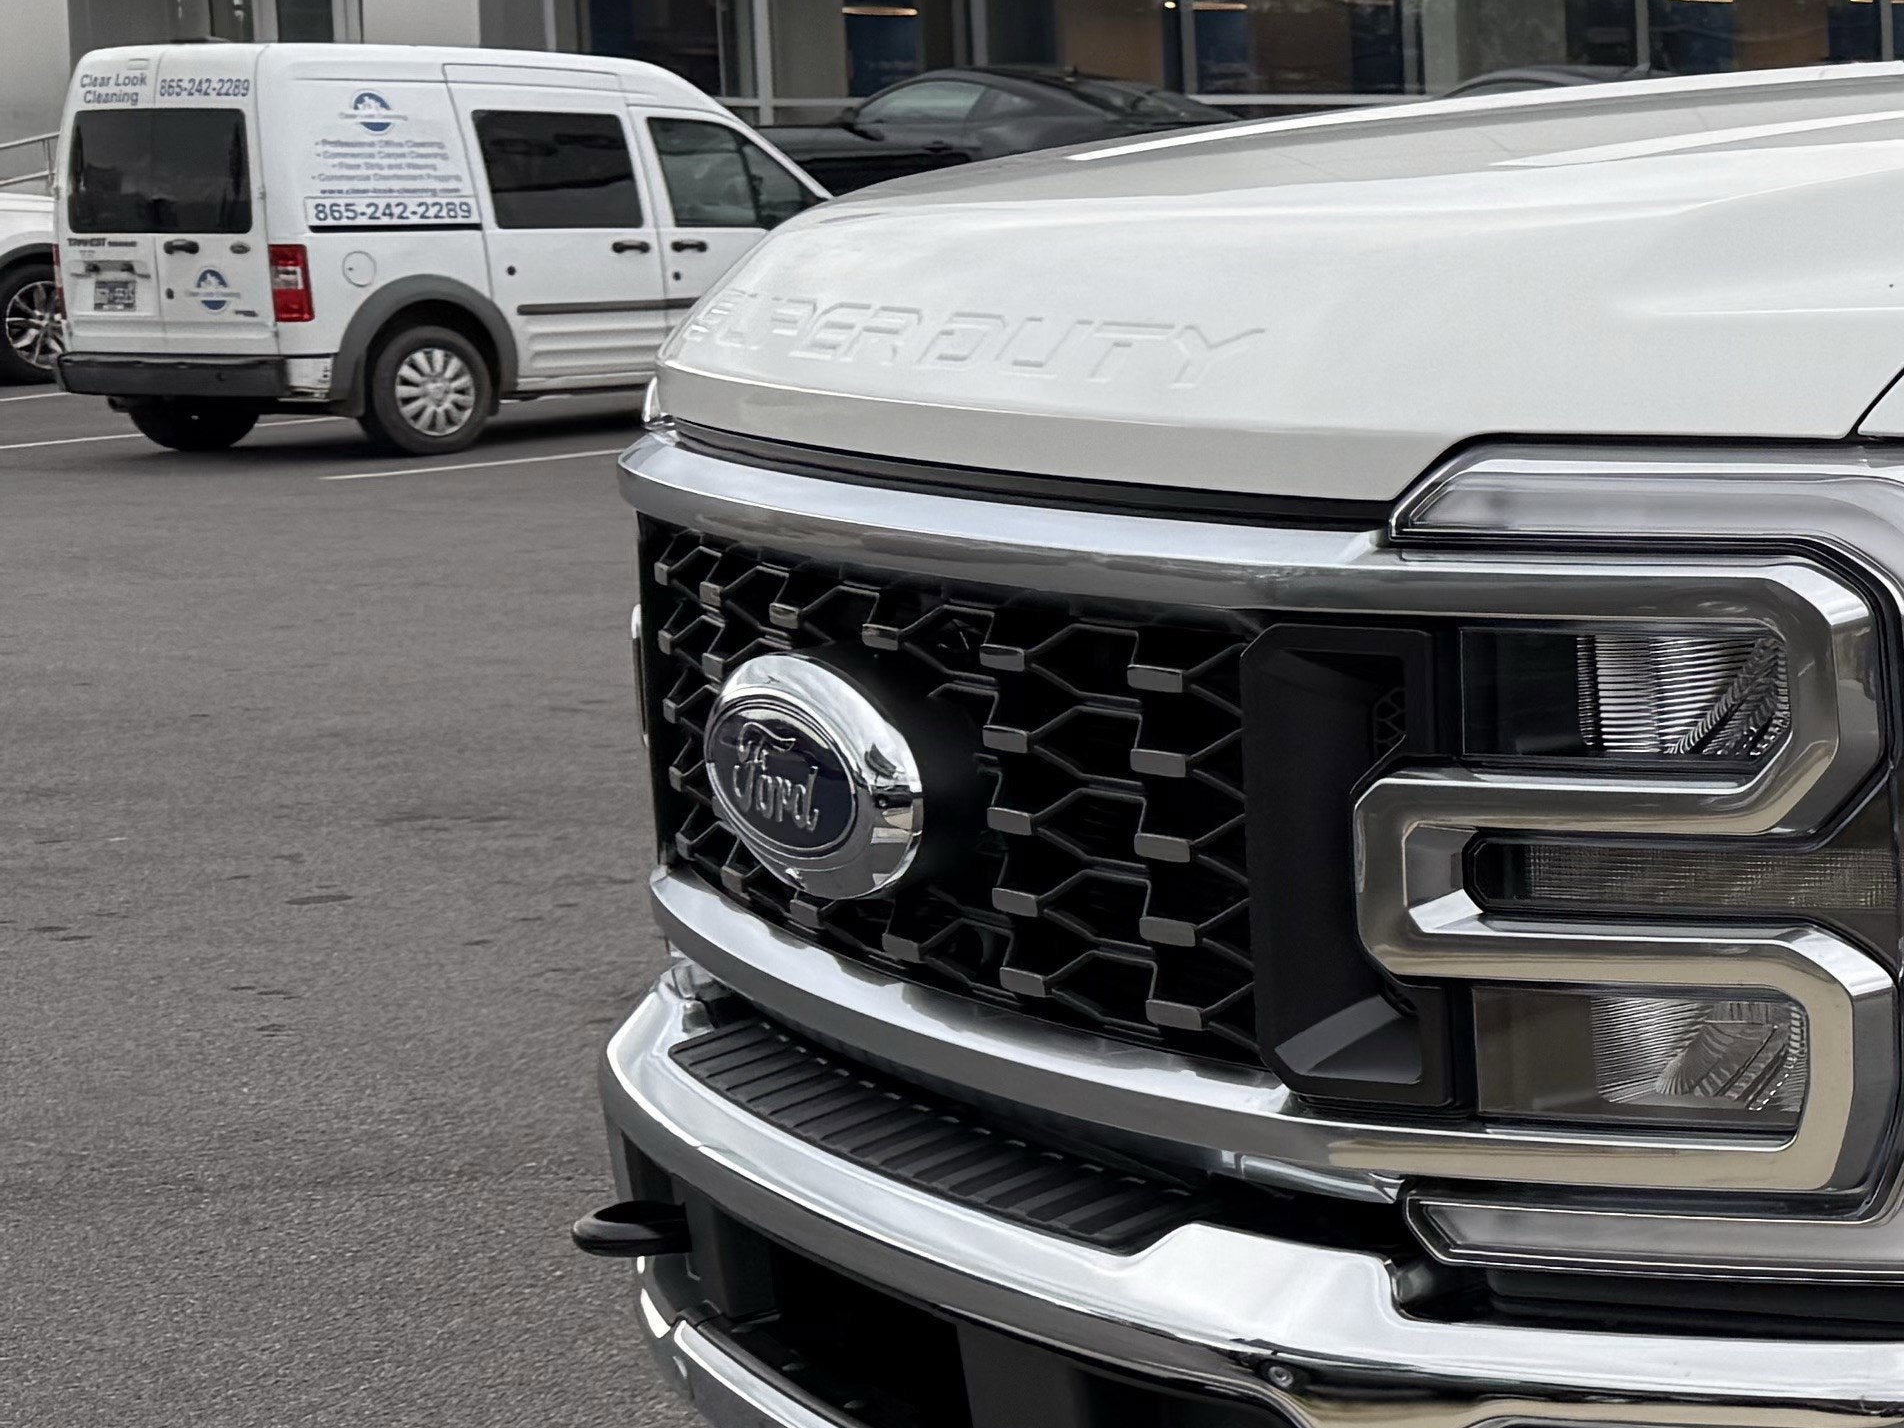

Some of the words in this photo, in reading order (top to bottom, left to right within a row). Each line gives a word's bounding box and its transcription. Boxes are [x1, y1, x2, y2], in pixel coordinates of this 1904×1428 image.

[80, 74, 110, 88] Clear
[114, 72, 147, 87] Look
[160, 78, 250, 97] 865-242-2289
[84, 89, 139, 106] Cleaning
[314, 201, 472, 221] 865-242-2289
[915, 310, 1266, 391] DUTY
[732, 721, 820, 833] Ford
